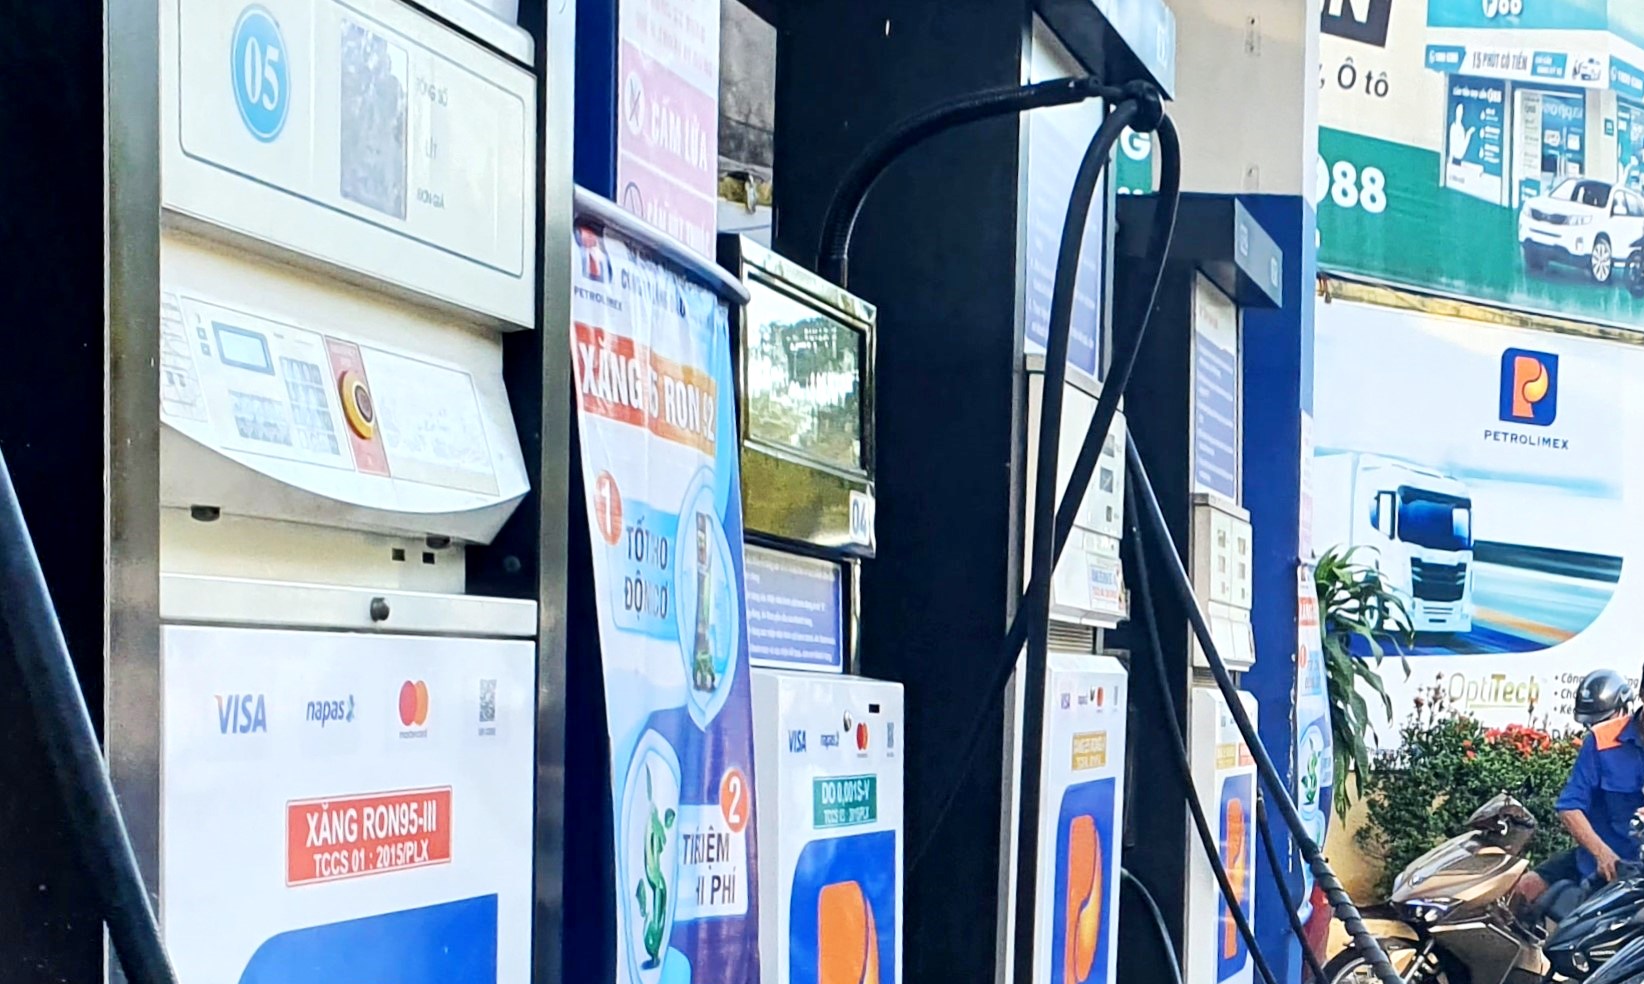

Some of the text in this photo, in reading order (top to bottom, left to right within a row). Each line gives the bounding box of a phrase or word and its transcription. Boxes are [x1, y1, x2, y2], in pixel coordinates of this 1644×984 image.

[244, 36, 280, 111] 05
[1337, 56, 1357, 90] Ô
[1365, 70, 1389, 98] tô
[579, 336, 644, 412] XĂNG
[663, 376, 700, 433] RON
[1484, 429, 1569, 450] PETROLIMEX
[651, 534, 669, 571] HO
[1448, 672, 1540, 708] OptiTech
[214, 694, 267, 734] VISA
[306, 697, 346, 728] napas
[788, 729, 807, 753] VISA
[728, 775, 741, 824] 2
[821, 780, 836, 804] DO
[306, 799, 437, 848] XĂNG RON95-III
[313, 852, 349, 878] TCCS
[352, 848, 366, 872] 01
[376, 839, 429, 868] 2015/PLX
[710, 866, 737, 906] PHÍ
